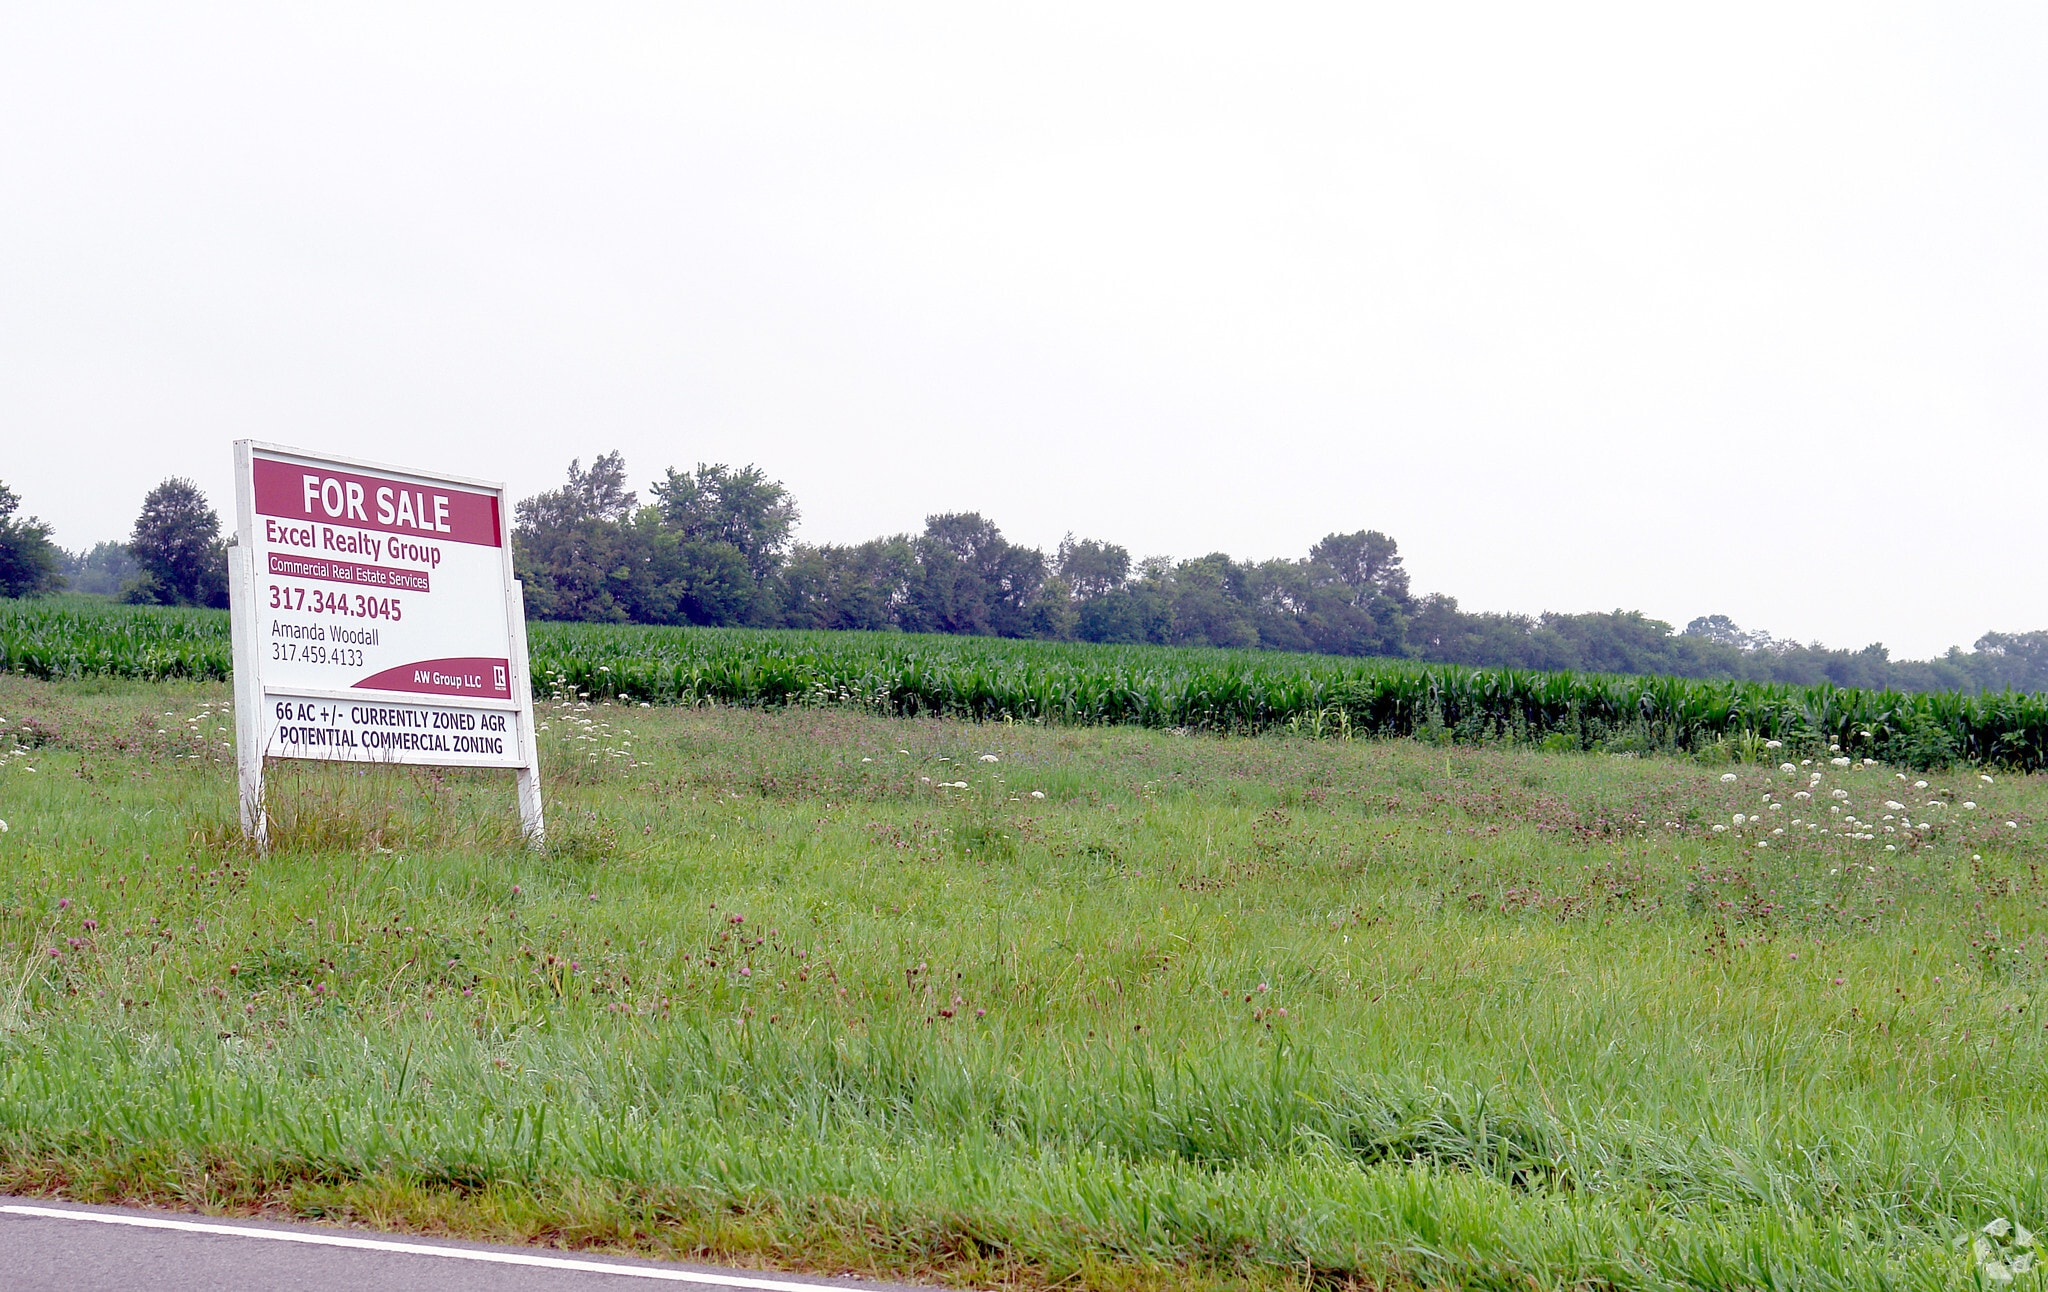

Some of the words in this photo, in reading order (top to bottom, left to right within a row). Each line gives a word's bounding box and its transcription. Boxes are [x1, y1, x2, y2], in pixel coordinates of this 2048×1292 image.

[302, 474, 368, 521] FOR
[376, 486, 451, 533] SALE
[266, 519, 316, 548] Excel
[323, 527, 381, 562] Realty
[387, 536, 441, 569] Group
[270, 557, 330, 577] Commercial
[332, 566, 353, 580] Real
[356, 568, 386, 585] Estate
[389, 571, 428, 589] Services
[269, 585, 402, 621] 317.344.3045
[272, 620, 325, 641] Amanda
[330, 625, 379, 646] Woodall
[272, 642, 363, 667] 317.459.4133
[414, 670, 430, 684] AW
[433, 672, 462, 689] Group
[464, 674, 482, 688] LLC
[275, 702, 293, 721] 66
[297, 703, 316, 722] AC
[320, 705, 343, 727] +/-
[351, 706, 428, 729] CURRENTLY
[433, 712, 475, 731] ZONED
[481, 714, 506, 733] AGR
[280, 726, 358, 747] POTENTIAL
[361, 731, 450, 752] COMMERCIAL
[453, 736, 503, 755] ZONING
